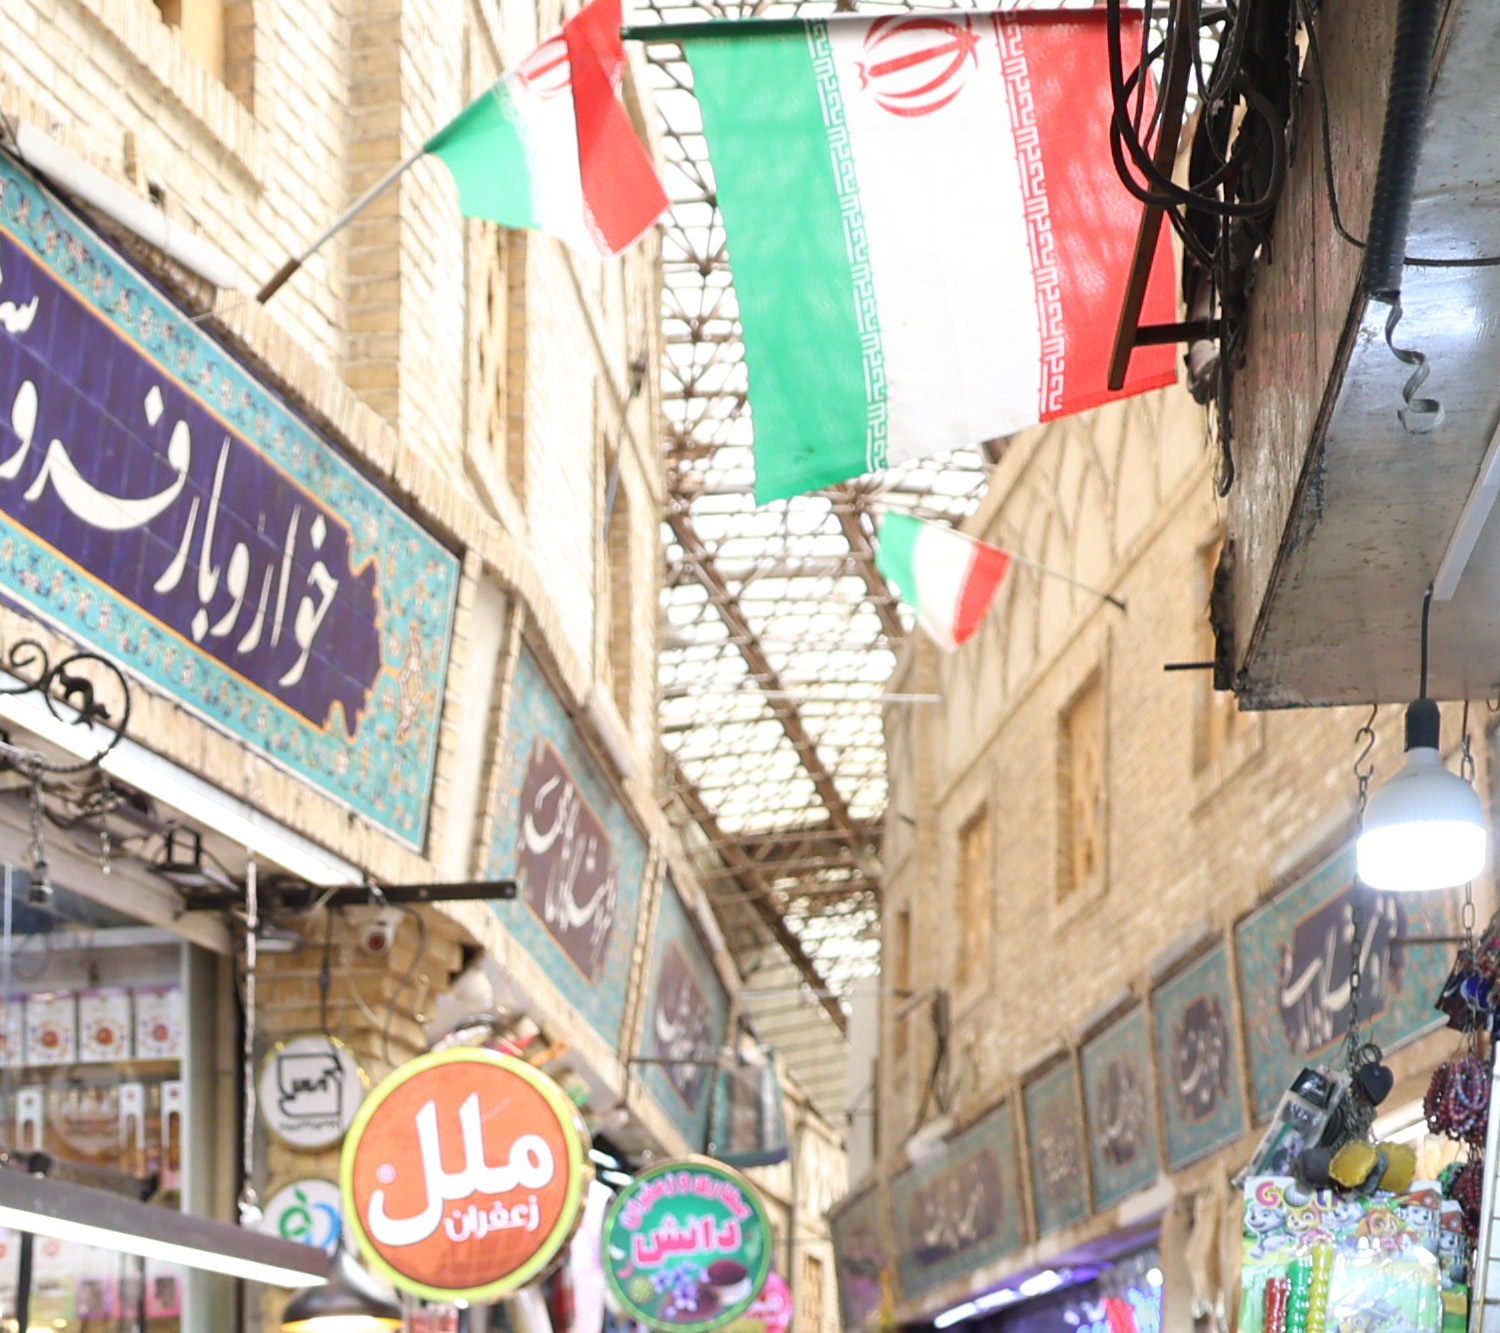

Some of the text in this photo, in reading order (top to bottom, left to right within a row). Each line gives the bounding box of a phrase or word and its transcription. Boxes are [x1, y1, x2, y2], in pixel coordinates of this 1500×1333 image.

[367, 1092, 555, 1246] ملل
[443, 1195, 541, 1242] زعفران
[630, 1212, 742, 1269] دانش
